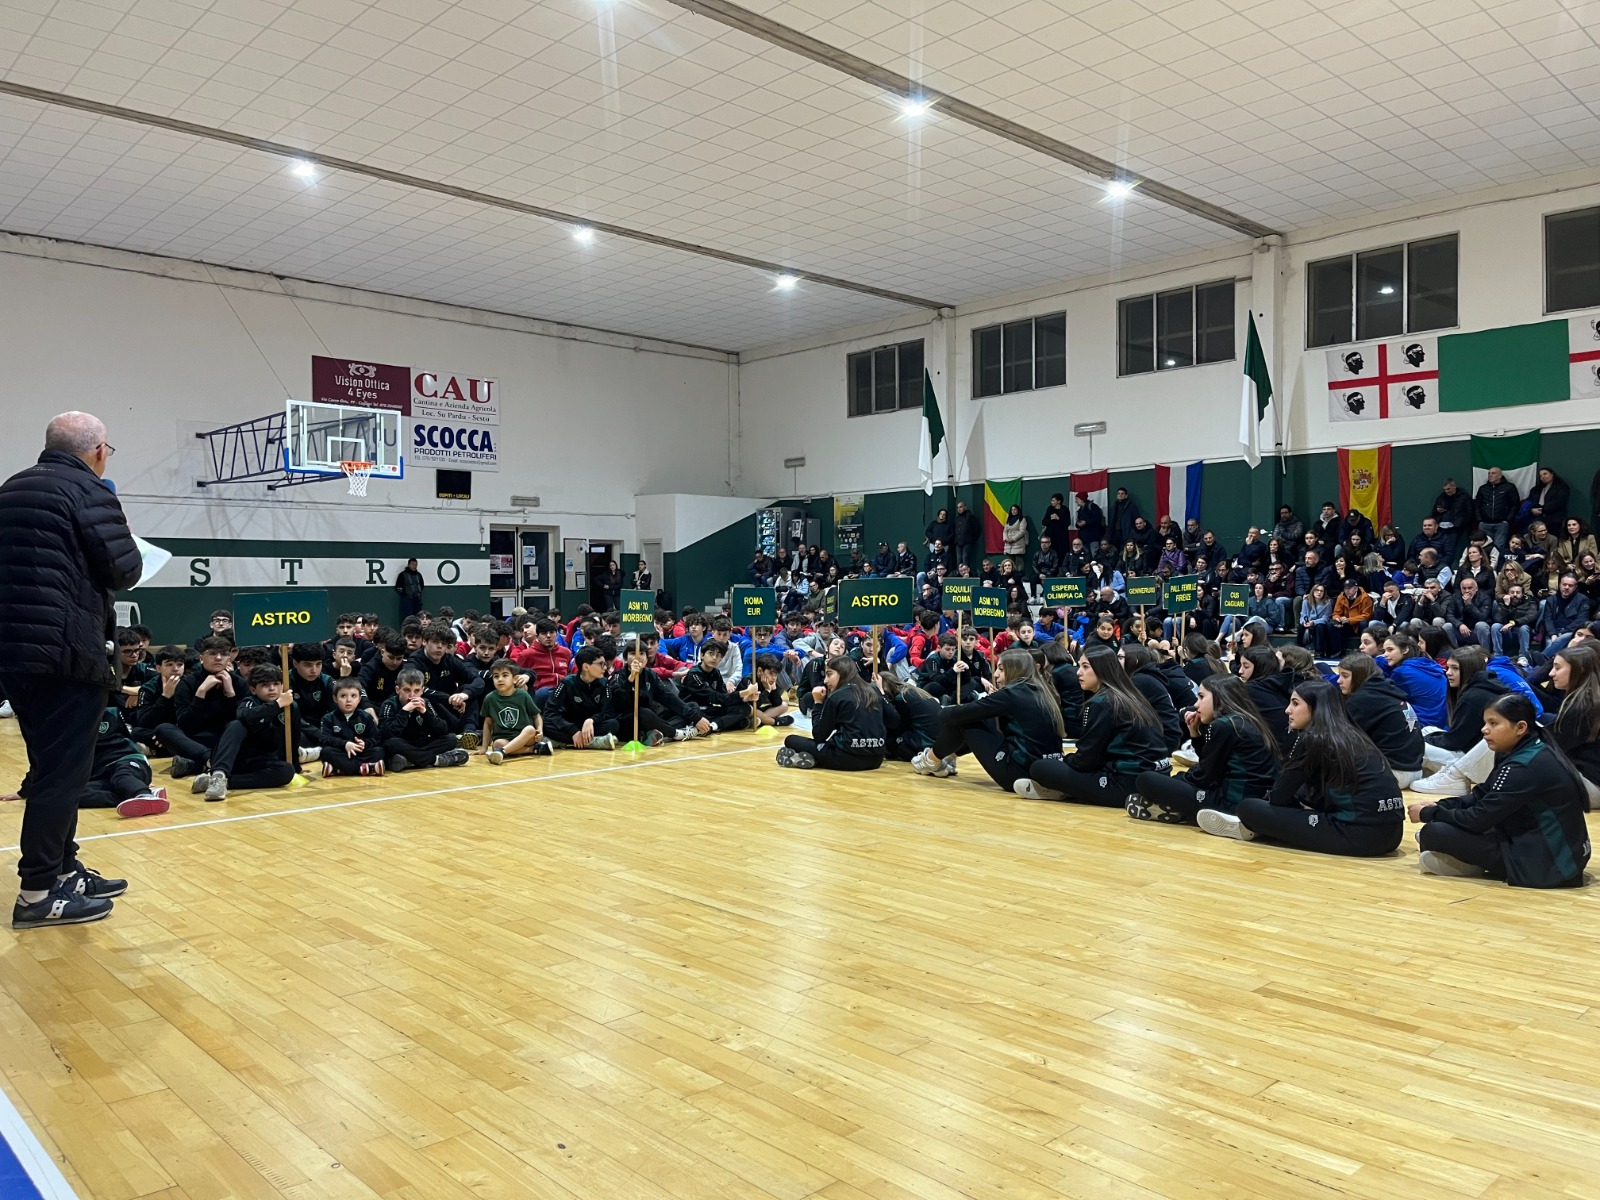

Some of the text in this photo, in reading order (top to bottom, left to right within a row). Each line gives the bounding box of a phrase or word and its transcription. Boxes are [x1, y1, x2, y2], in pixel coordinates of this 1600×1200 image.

[335, 375, 390, 391] Vision Ottica
[414, 372, 494, 404] CAU
[348, 388, 377, 400] 4 Eyes
[413, 397, 438, 406] Cantina
[444, 401, 469, 410] Azienda
[471, 404, 496, 413] Agricola
[422, 409, 435, 417] Loc.
[437, 410, 446, 418] Su
[448, 412, 466, 420] Pardu
[413, 423, 494, 453] SCOCCA
[414, 447, 497, 460] PRODOTTI PETROLIFERI
[945, 585, 971, 593] ESQUILI
[743, 596, 764, 605] ROMA
[851, 593, 899, 608] ASTRO
[952, 595, 971, 603] ROMA
[978, 596, 991, 605] ASM
[1047, 592, 1073, 600] OLIMPIA
[1229, 591, 1240, 599] CUS
[628, 601, 649, 610] ASM '70
[747, 607, 761, 616] EUR
[974, 607, 1005, 618] MORBEGNO
[251, 610, 311, 627] ASTRO
[622, 613, 653, 622] MORBEGNO
[850, 737, 885, 748] ASTRO
